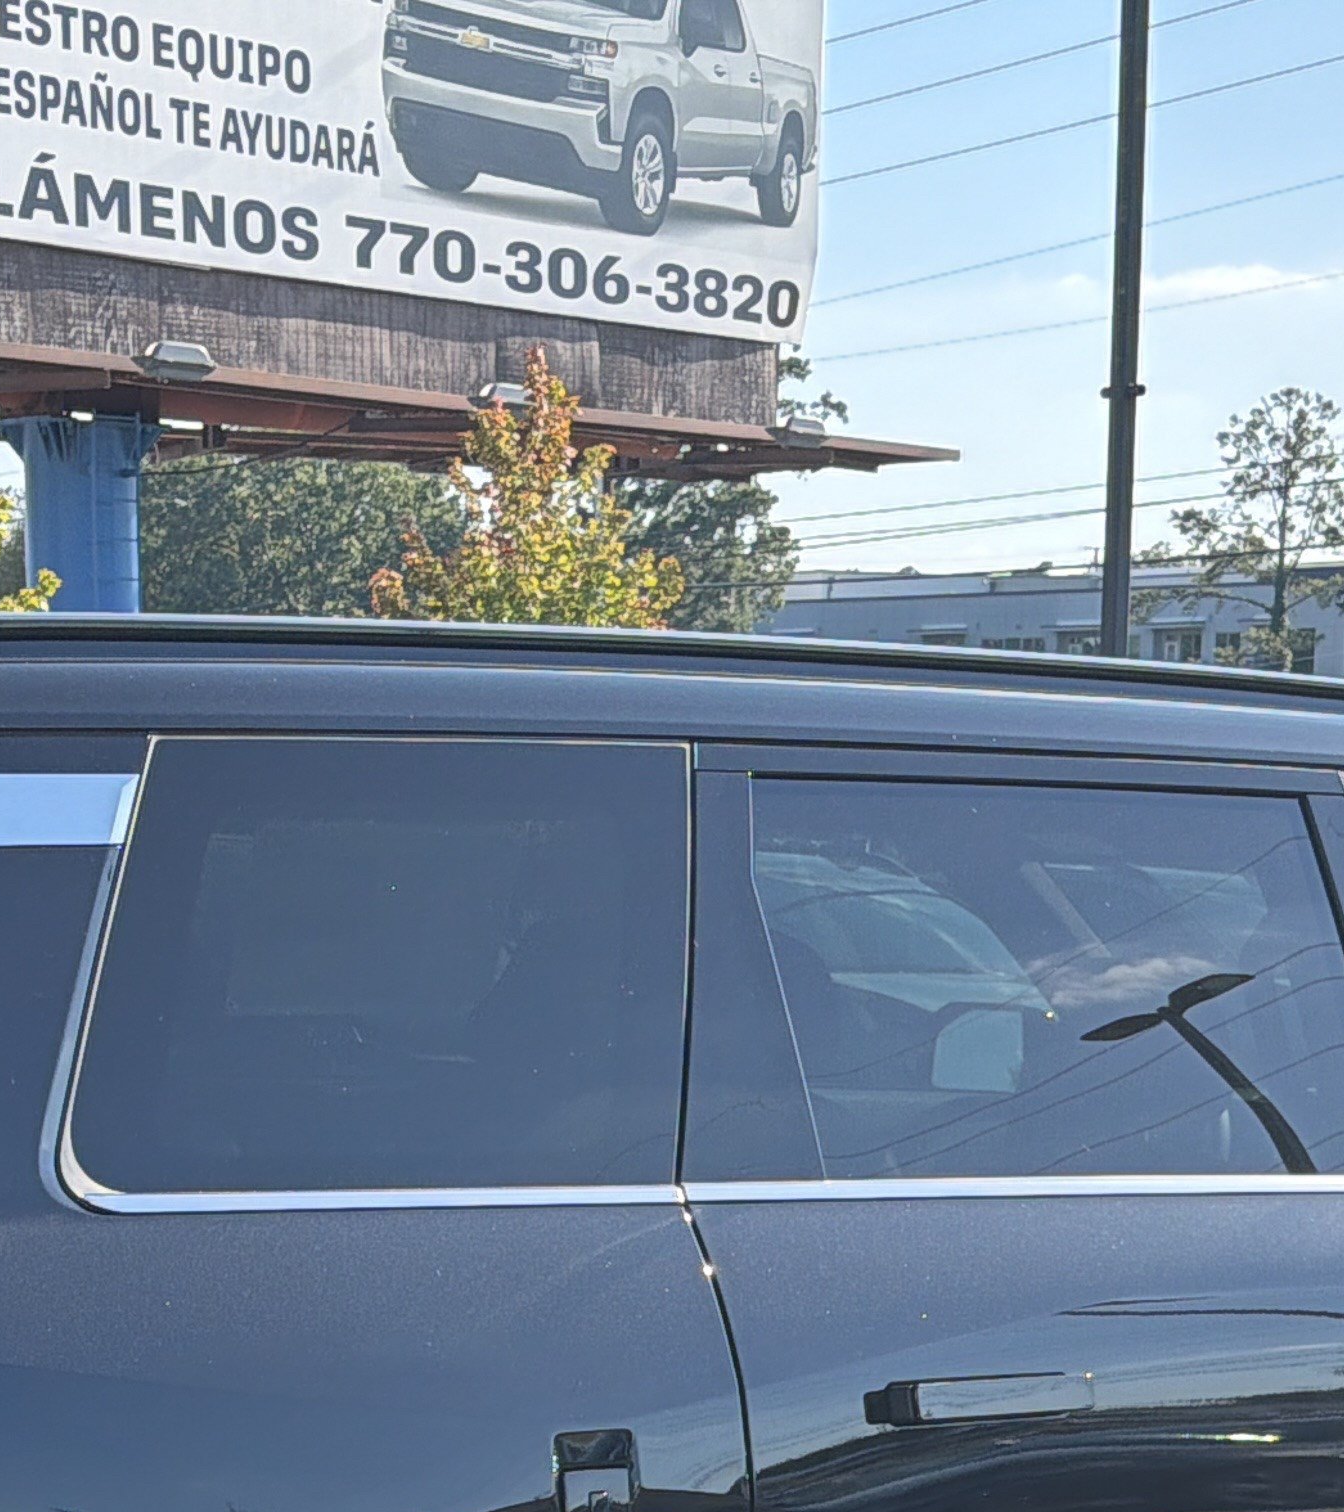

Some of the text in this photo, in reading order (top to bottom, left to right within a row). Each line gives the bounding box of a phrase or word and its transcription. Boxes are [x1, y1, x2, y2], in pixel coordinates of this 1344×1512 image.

[152, 22, 312, 95] EQUIPO
[169, 97, 212, 148] TE
[219, 108, 381, 177] AYUDARÁ
[345, 214, 801, 329] 770-306-3820
